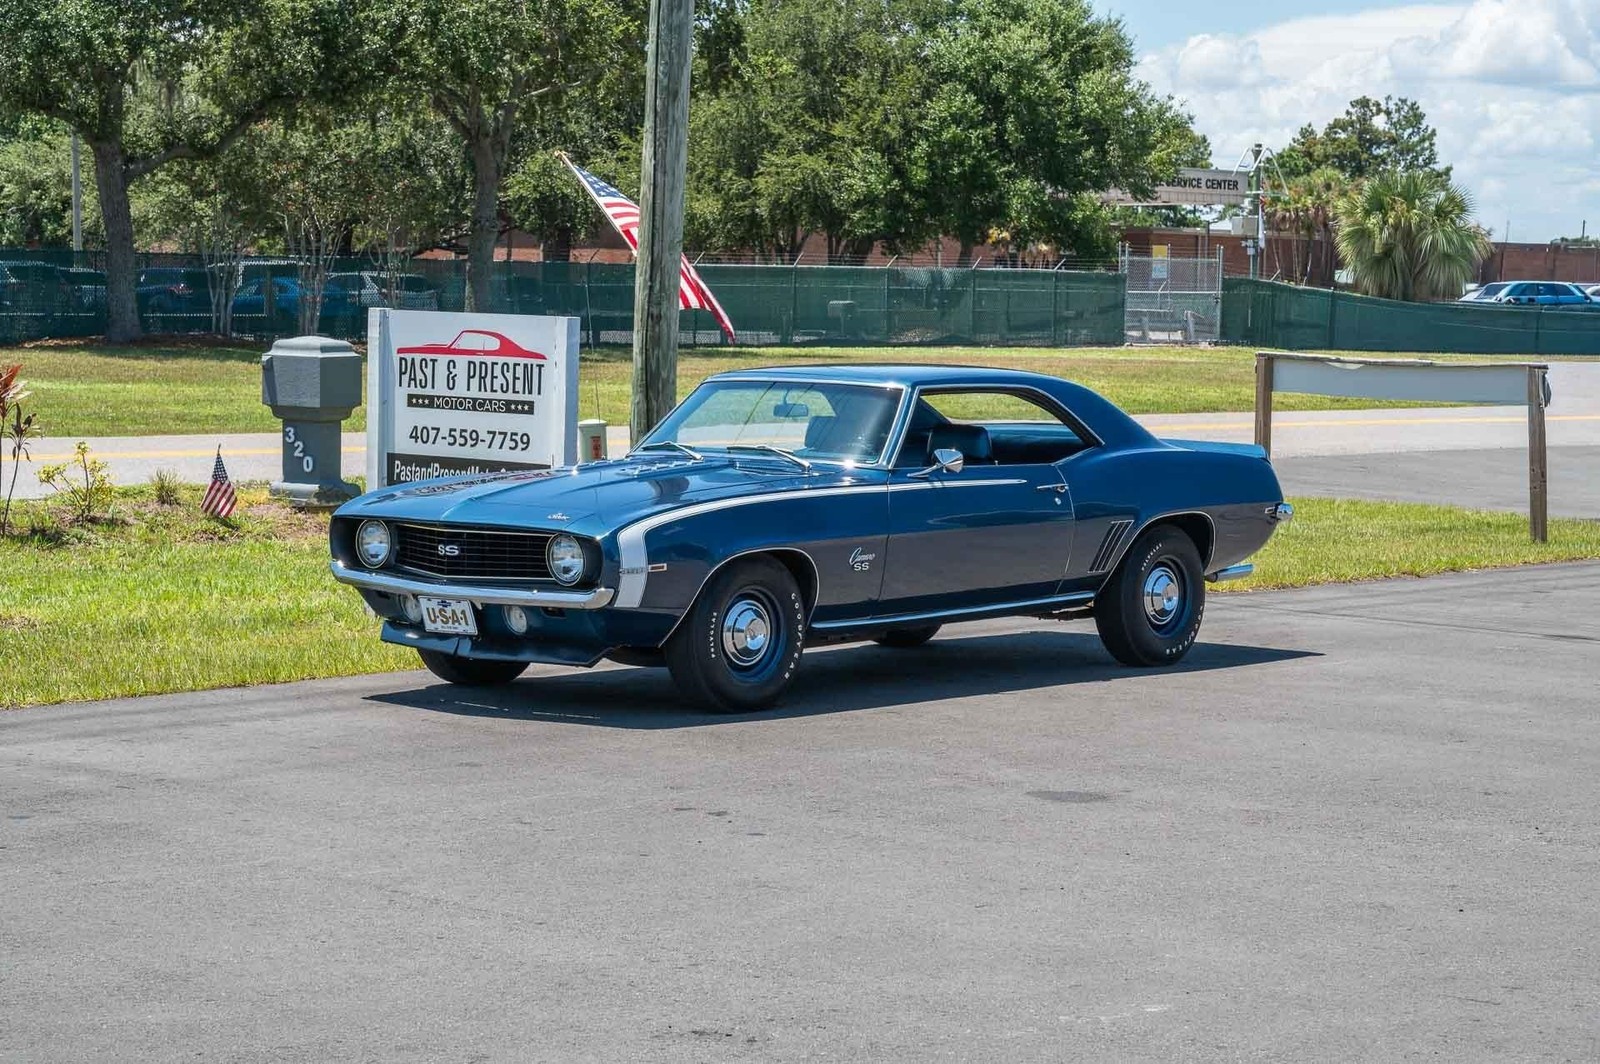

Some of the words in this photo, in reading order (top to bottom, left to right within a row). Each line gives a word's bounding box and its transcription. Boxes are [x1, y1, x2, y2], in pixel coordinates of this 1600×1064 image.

[1205, 178, 1239, 191] CENTER
[398, 356, 438, 390] PAST
[447, 359, 458, 390] &
[466, 360, 545, 396] PRESENT
[434, 397, 473, 410] MOTOR
[476, 400, 506, 412] CARS
[409, 425, 531, 451] 407-559-7759
[438, 544, 459, 556] SS
[854, 563, 870, 571] SS
